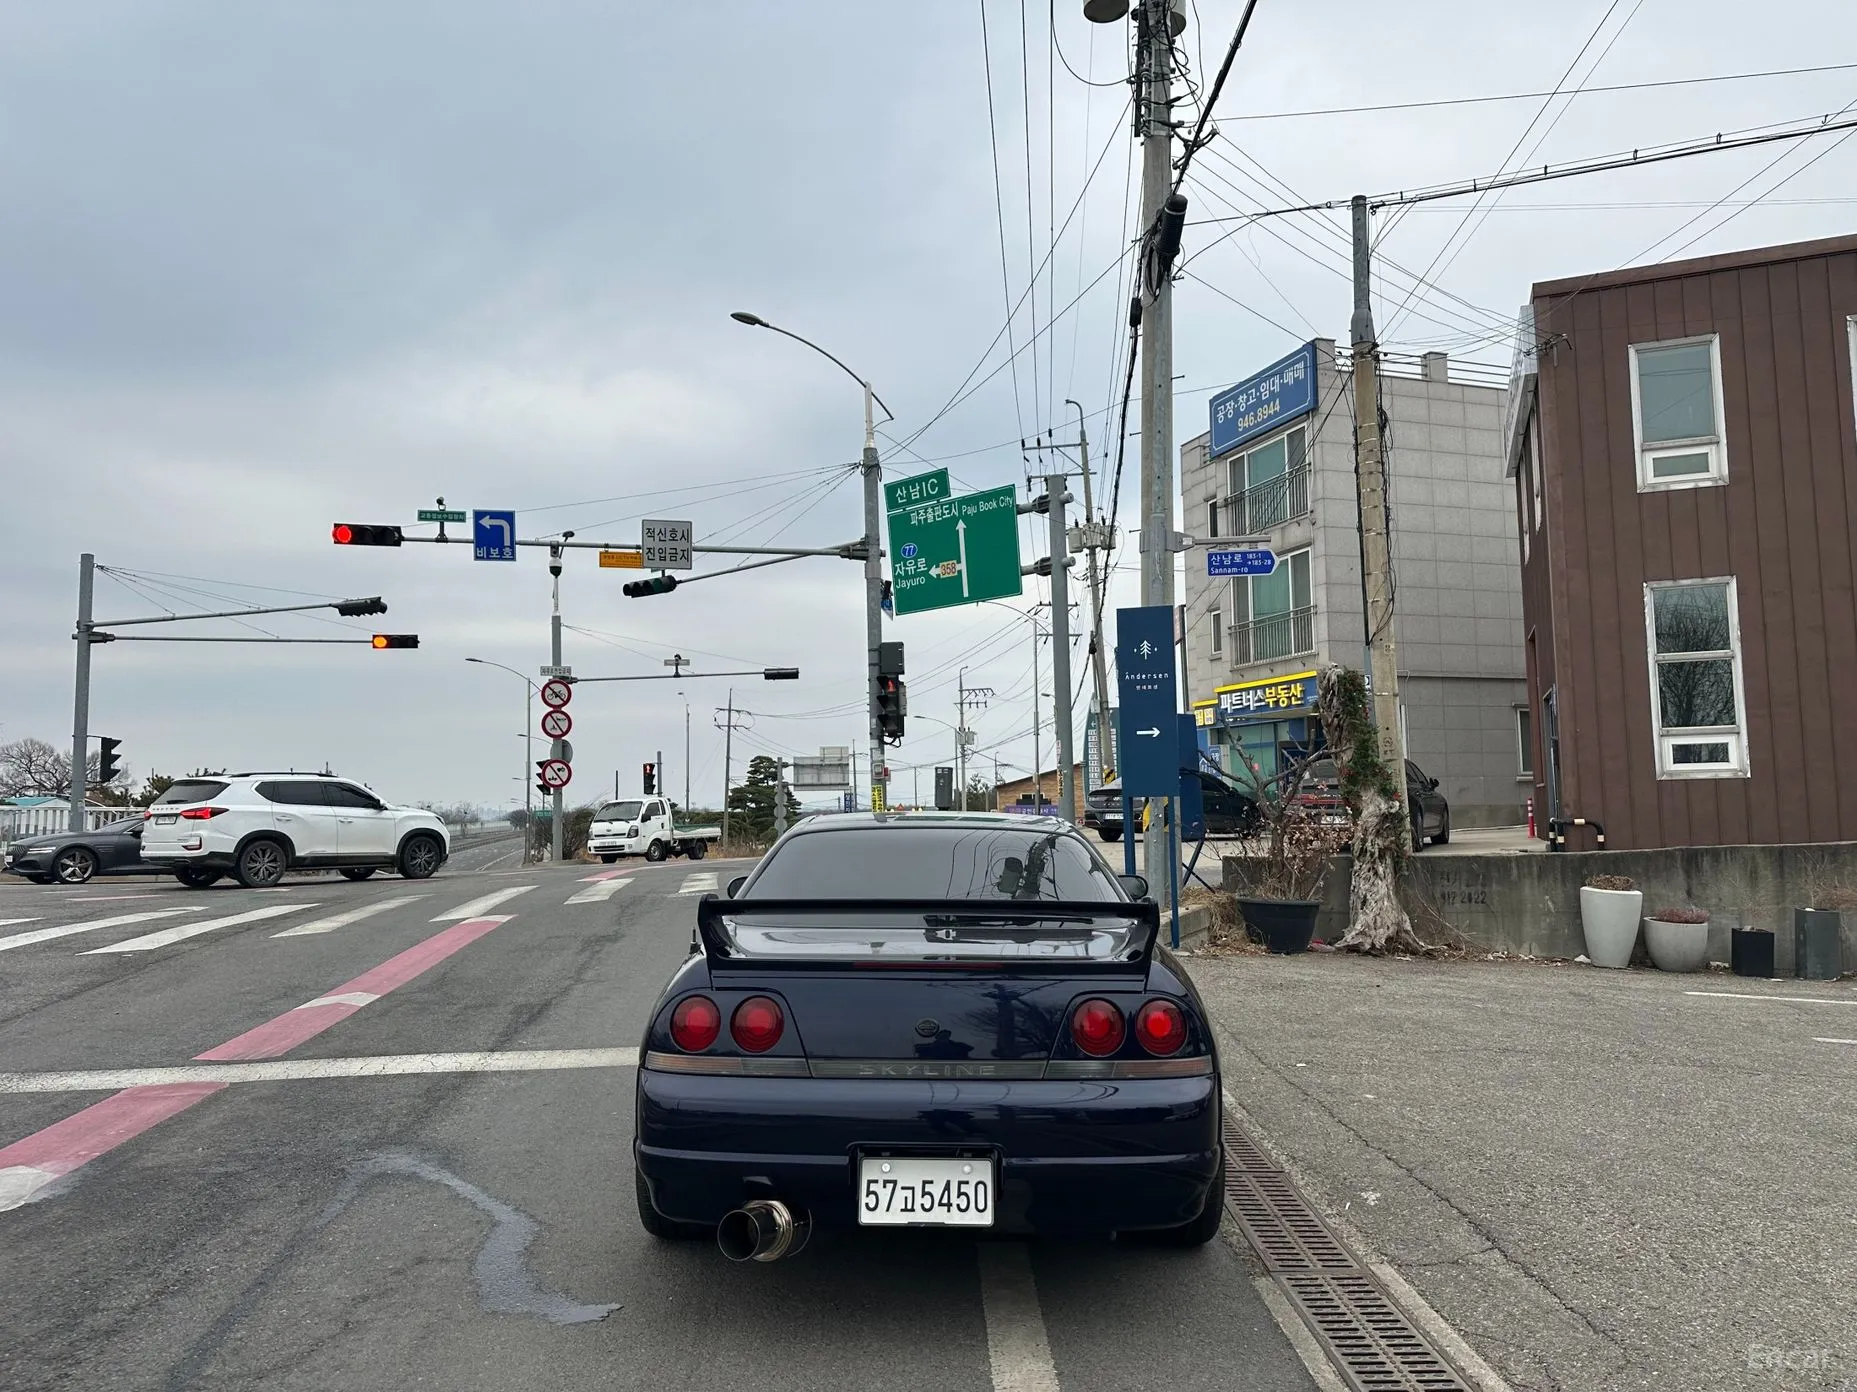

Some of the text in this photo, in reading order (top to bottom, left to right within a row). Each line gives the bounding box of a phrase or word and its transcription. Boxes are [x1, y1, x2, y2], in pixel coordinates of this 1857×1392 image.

[1238, 398, 1280, 431] 946.8944
[895, 478, 939, 503] 산남IC
[910, 495, 1014, 526] 파주출판도시 Paju Book City
[645, 527, 690, 543] 적신호시
[476, 546, 514, 559] 비보호
[645, 546, 690, 563] 진입금지
[904, 545, 915, 557] 77
[1210, 553, 1243, 565] 산남로
[895, 557, 928, 577] 자유로
[940, 562, 957, 576] 358
[896, 575, 926, 589] Jayuro
[1220, 682, 1305, 713] 파트너스부동산
[859, 1065, 996, 1076] SKYLINE
[864, 1178, 988, 1213] 57고5450
